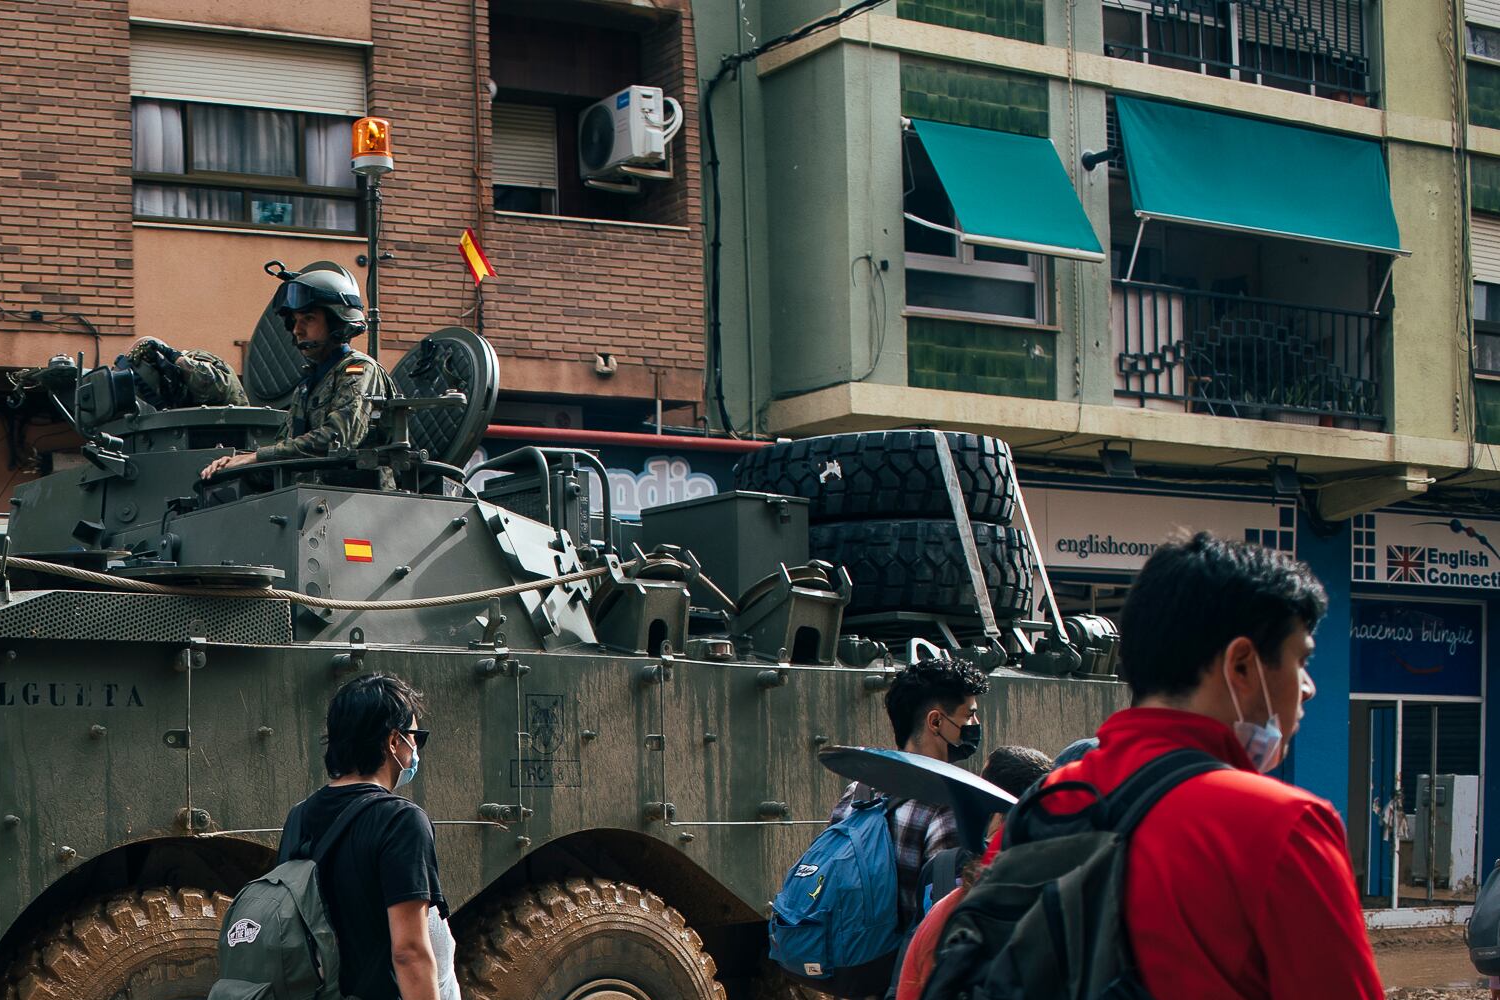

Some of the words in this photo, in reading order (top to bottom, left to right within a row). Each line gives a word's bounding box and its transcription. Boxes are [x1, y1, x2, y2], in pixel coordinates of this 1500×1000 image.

[1427, 548, 1489, 569] English
[1427, 567, 1500, 587] Connecti
[1349, 616, 1413, 642] hacemos
[1421, 619, 1475, 656] bilingüe
